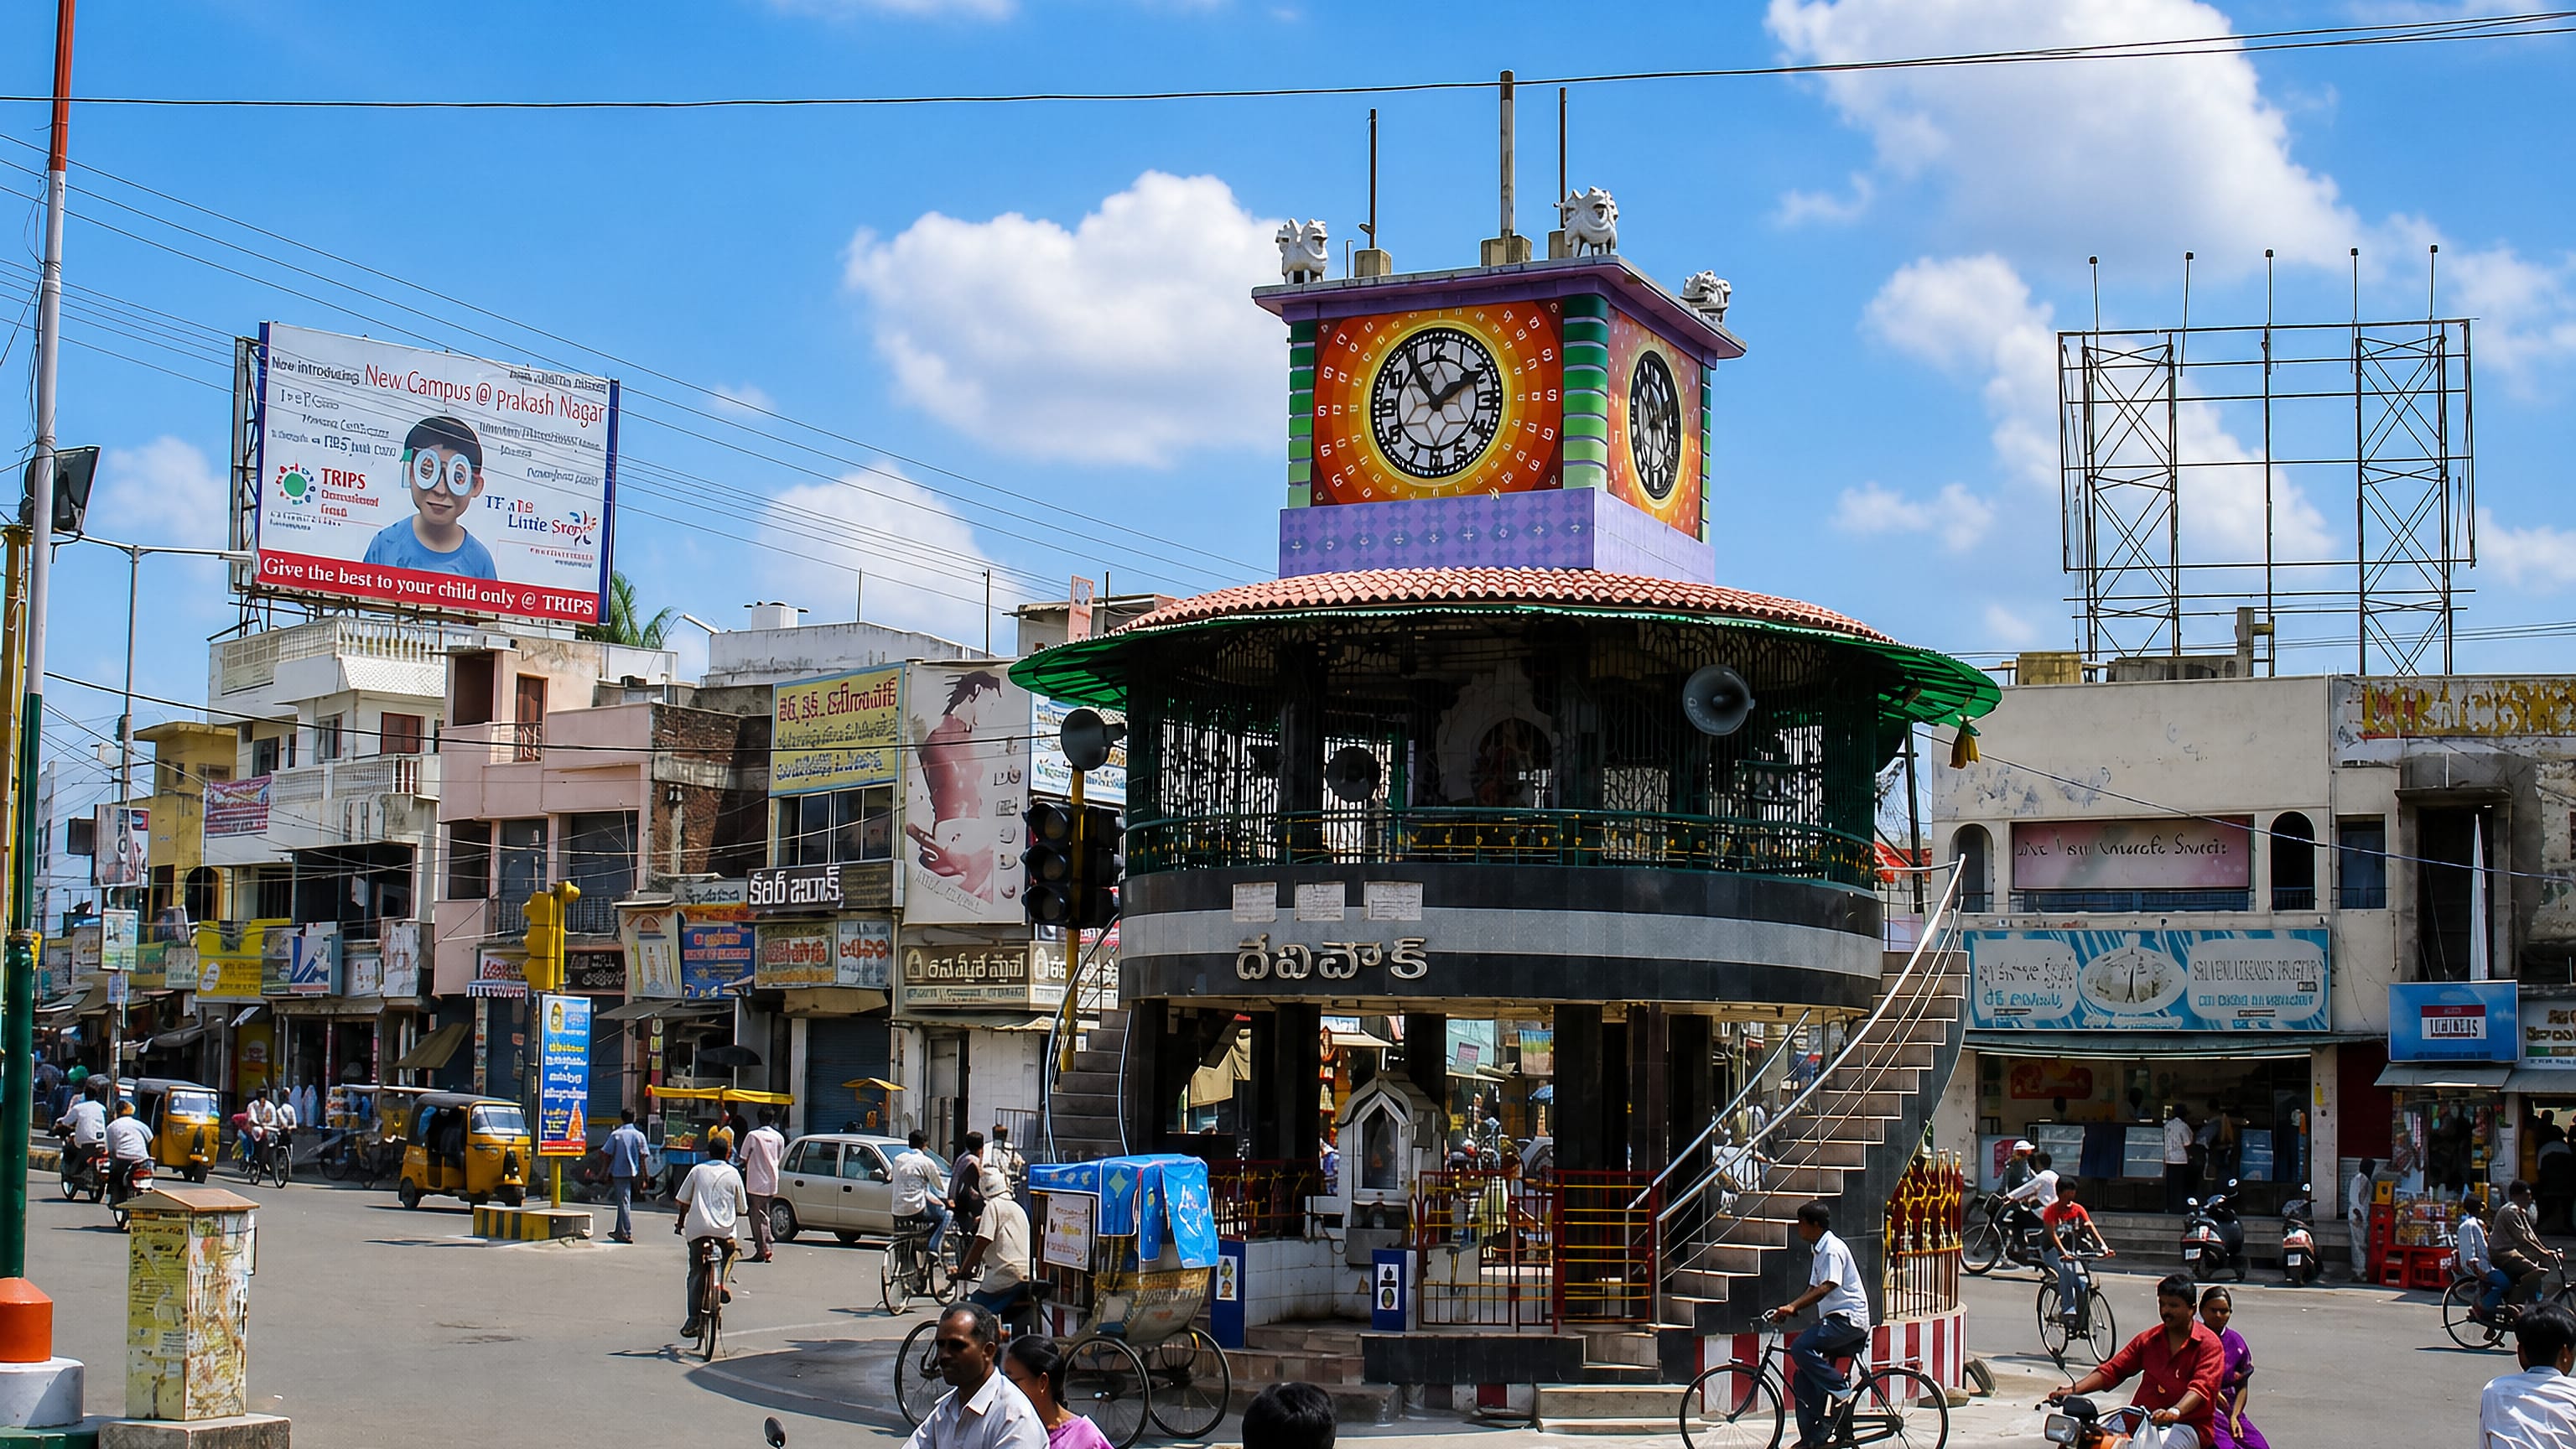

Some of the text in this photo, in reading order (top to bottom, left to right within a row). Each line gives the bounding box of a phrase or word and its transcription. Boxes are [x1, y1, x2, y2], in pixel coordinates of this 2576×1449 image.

[366, 363, 403, 390] New
[407, 371, 471, 402] Campus
[476, 382, 492, 406] @
[560, 396, 606, 428] Nagar
[320, 467, 366, 491] TRIPS
[263, 557, 594, 615] Give the best to your child only @ TRIPS
